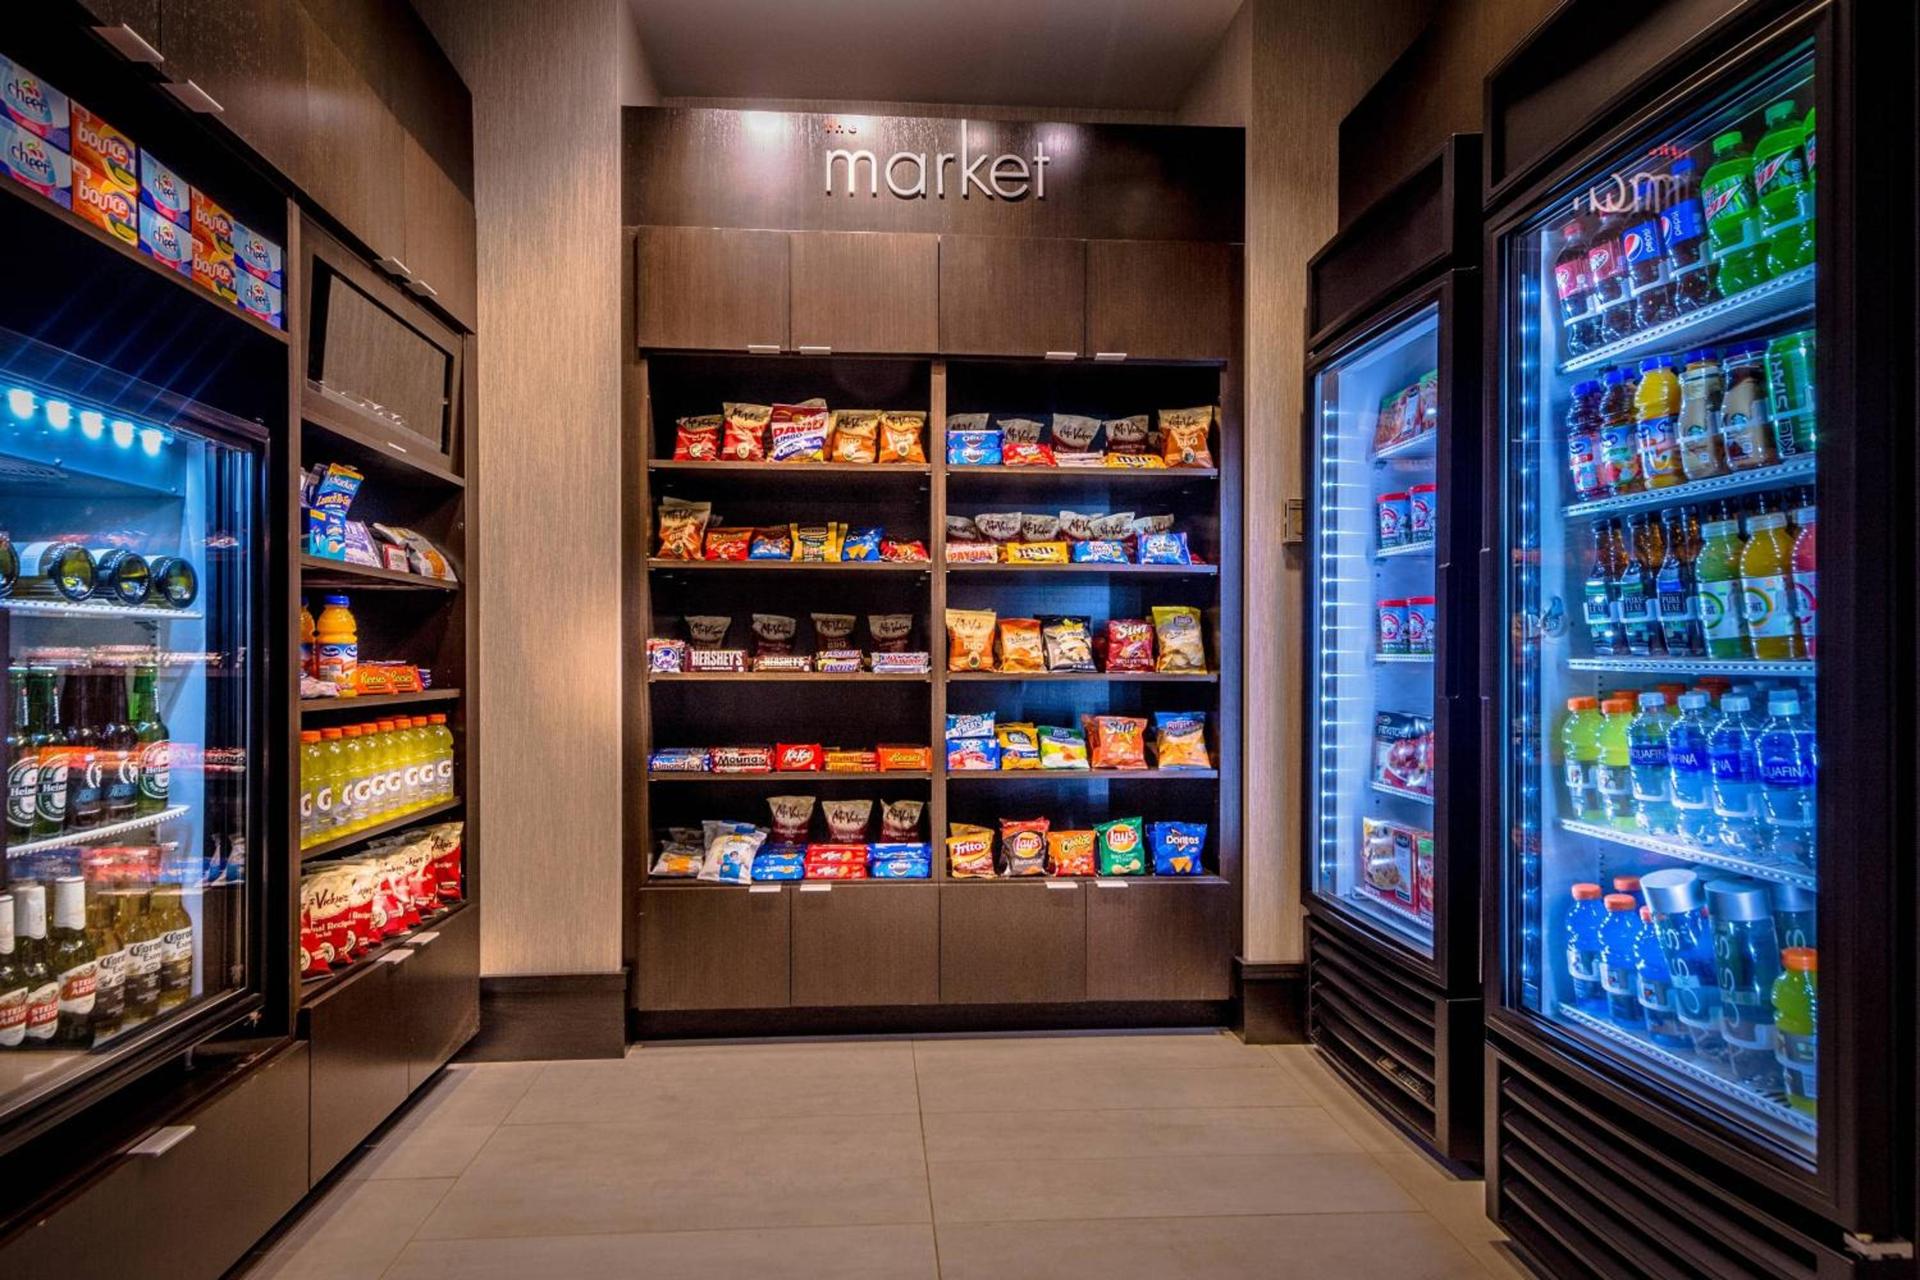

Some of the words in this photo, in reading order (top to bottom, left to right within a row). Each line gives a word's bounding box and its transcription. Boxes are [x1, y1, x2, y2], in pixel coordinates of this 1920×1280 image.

[79, 122, 127, 159] bounce
[826, 119, 1050, 200] market
[80, 179, 128, 217] bounce
[1671, 211, 1683, 236] pepsi
[1643, 228, 1654, 253] pepsi
[773, 417, 825, 437] DAVID
[1115, 623, 1148, 639] Sun
[692, 651, 742, 666] HERSHEY'S
[718, 756, 765, 768] Mounds
[1017, 836, 1040, 850] Lay's
[1110, 829, 1136, 844] Lay's
[1166, 834, 1199, 845] Doritos
[953, 842, 986, 855] Fritos
